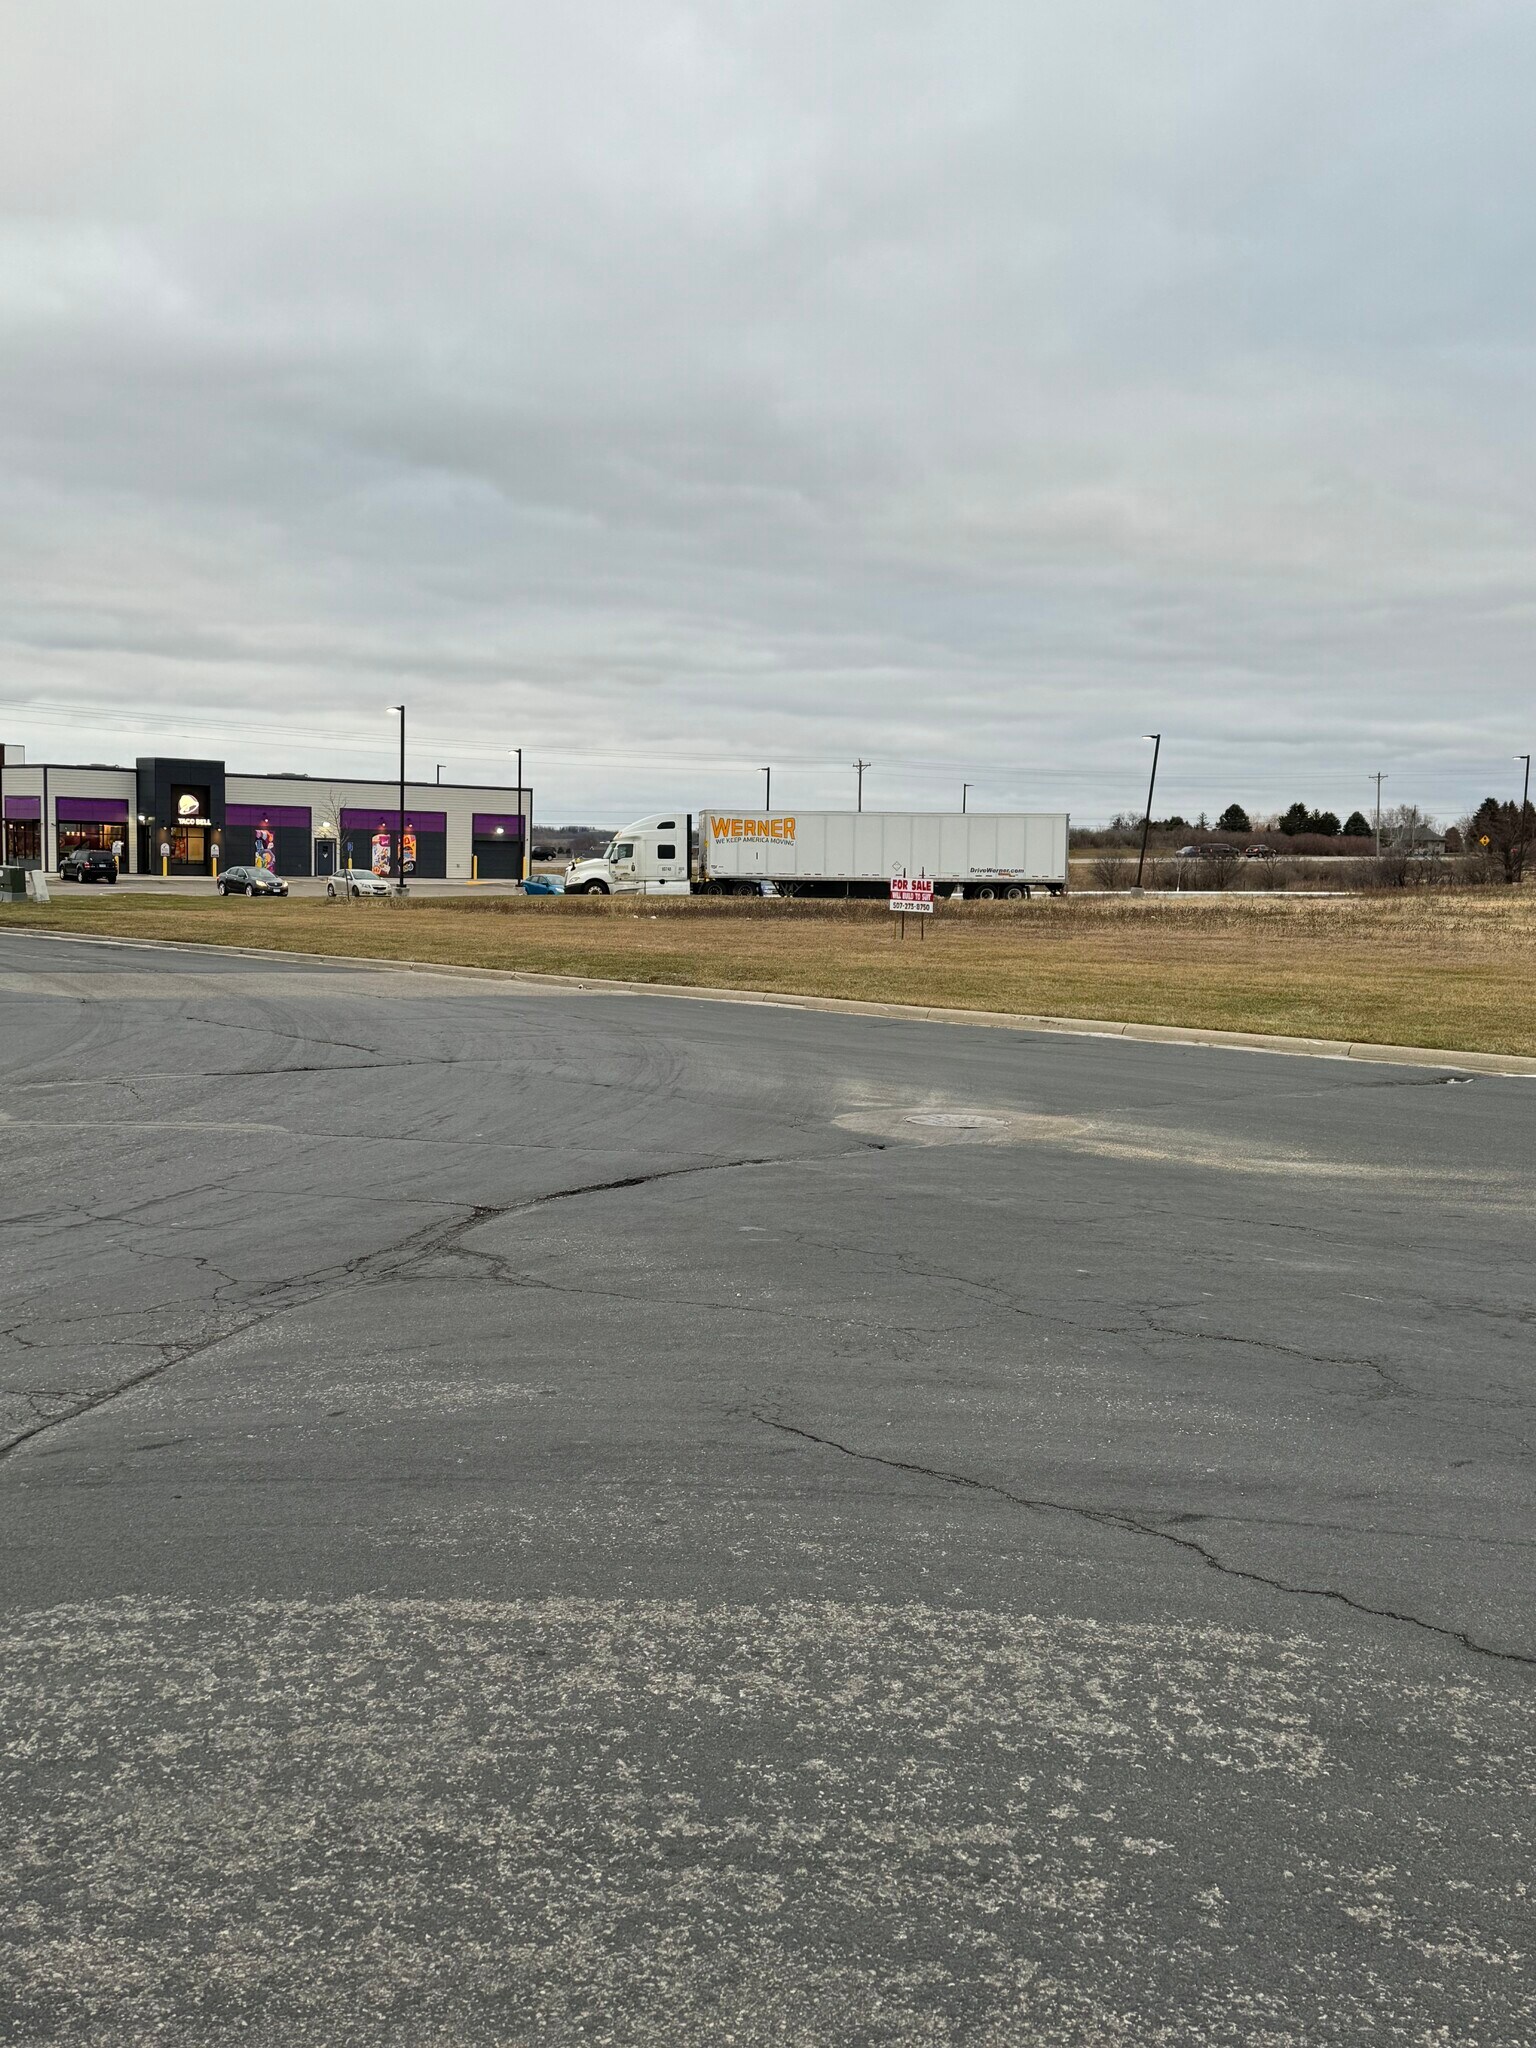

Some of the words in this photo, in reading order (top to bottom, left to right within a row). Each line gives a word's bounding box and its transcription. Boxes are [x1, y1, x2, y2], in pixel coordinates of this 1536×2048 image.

[710, 816, 796, 839] WERNER
[770, 838, 794, 846] MOVING
[892, 879, 908, 890] FOR
[911, 880, 932, 891] SALE
